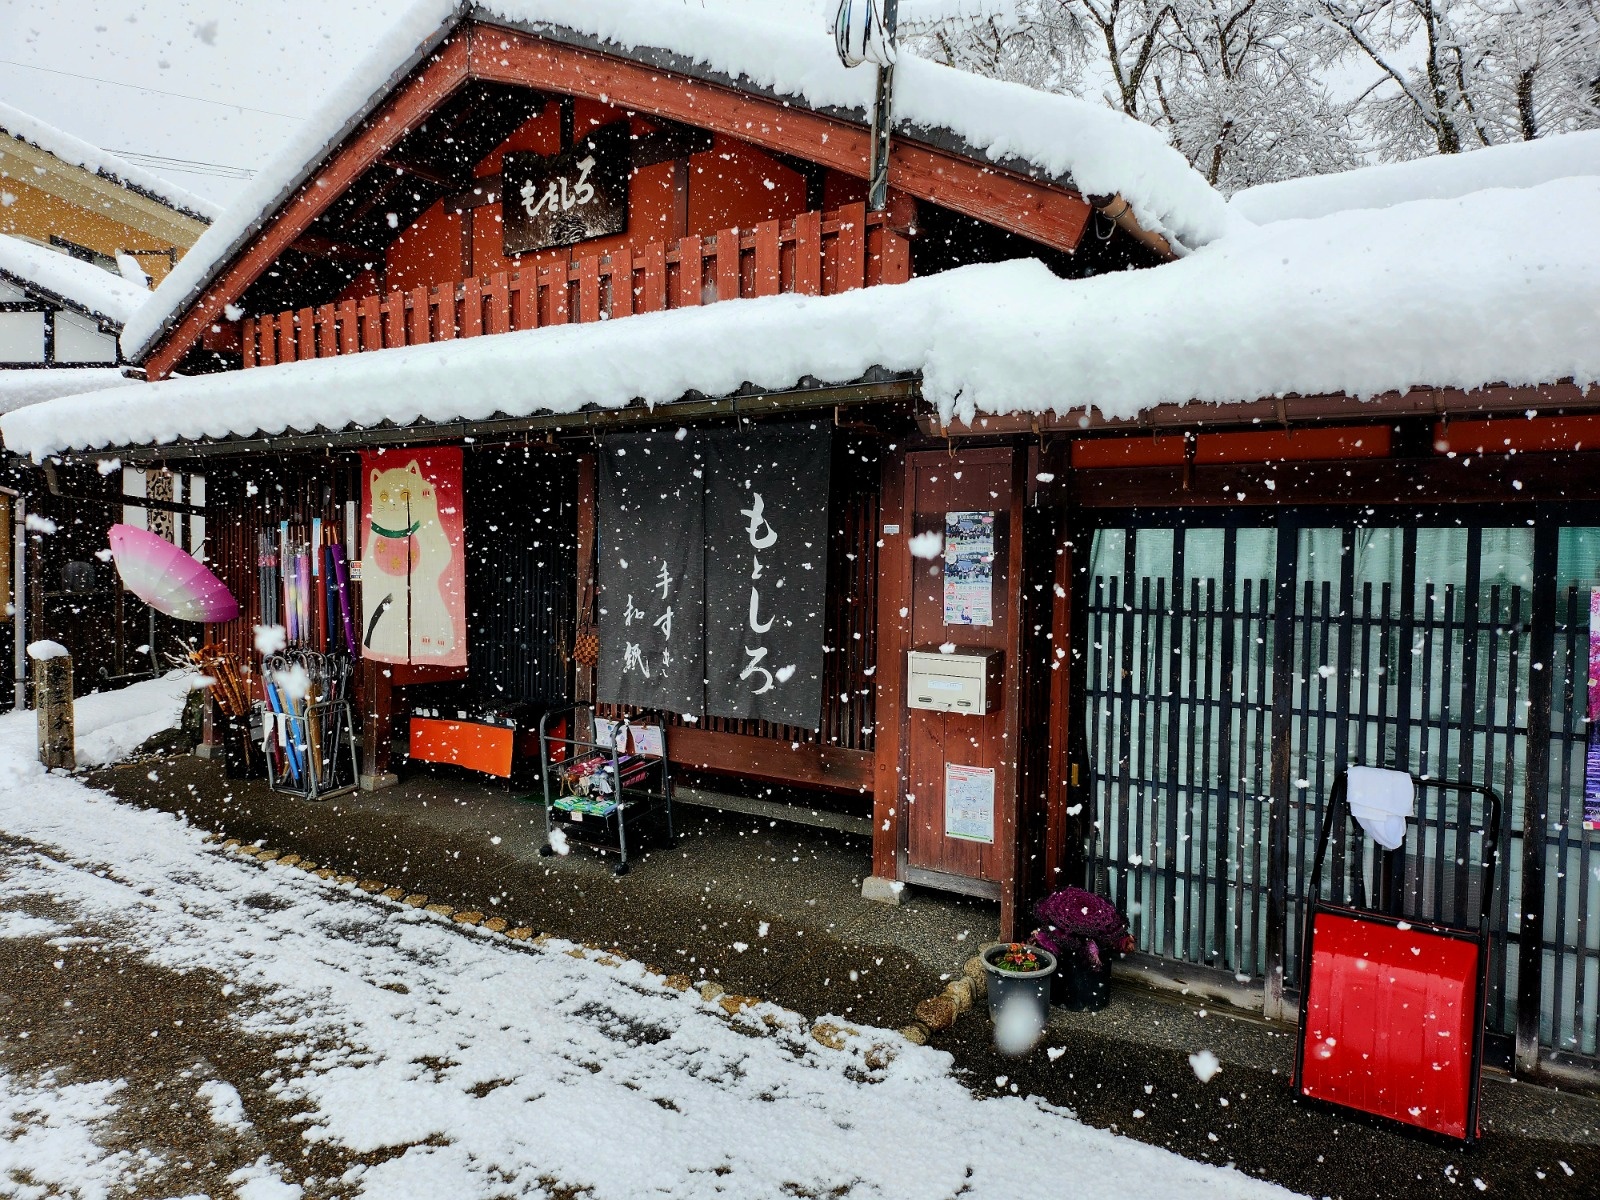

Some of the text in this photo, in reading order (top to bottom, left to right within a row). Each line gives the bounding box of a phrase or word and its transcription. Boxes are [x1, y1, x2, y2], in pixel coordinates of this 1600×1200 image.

[623, 594, 650, 679] 和紙
[653, 560, 674, 678] 手すき
[740, 492, 778, 695] もとしろ
